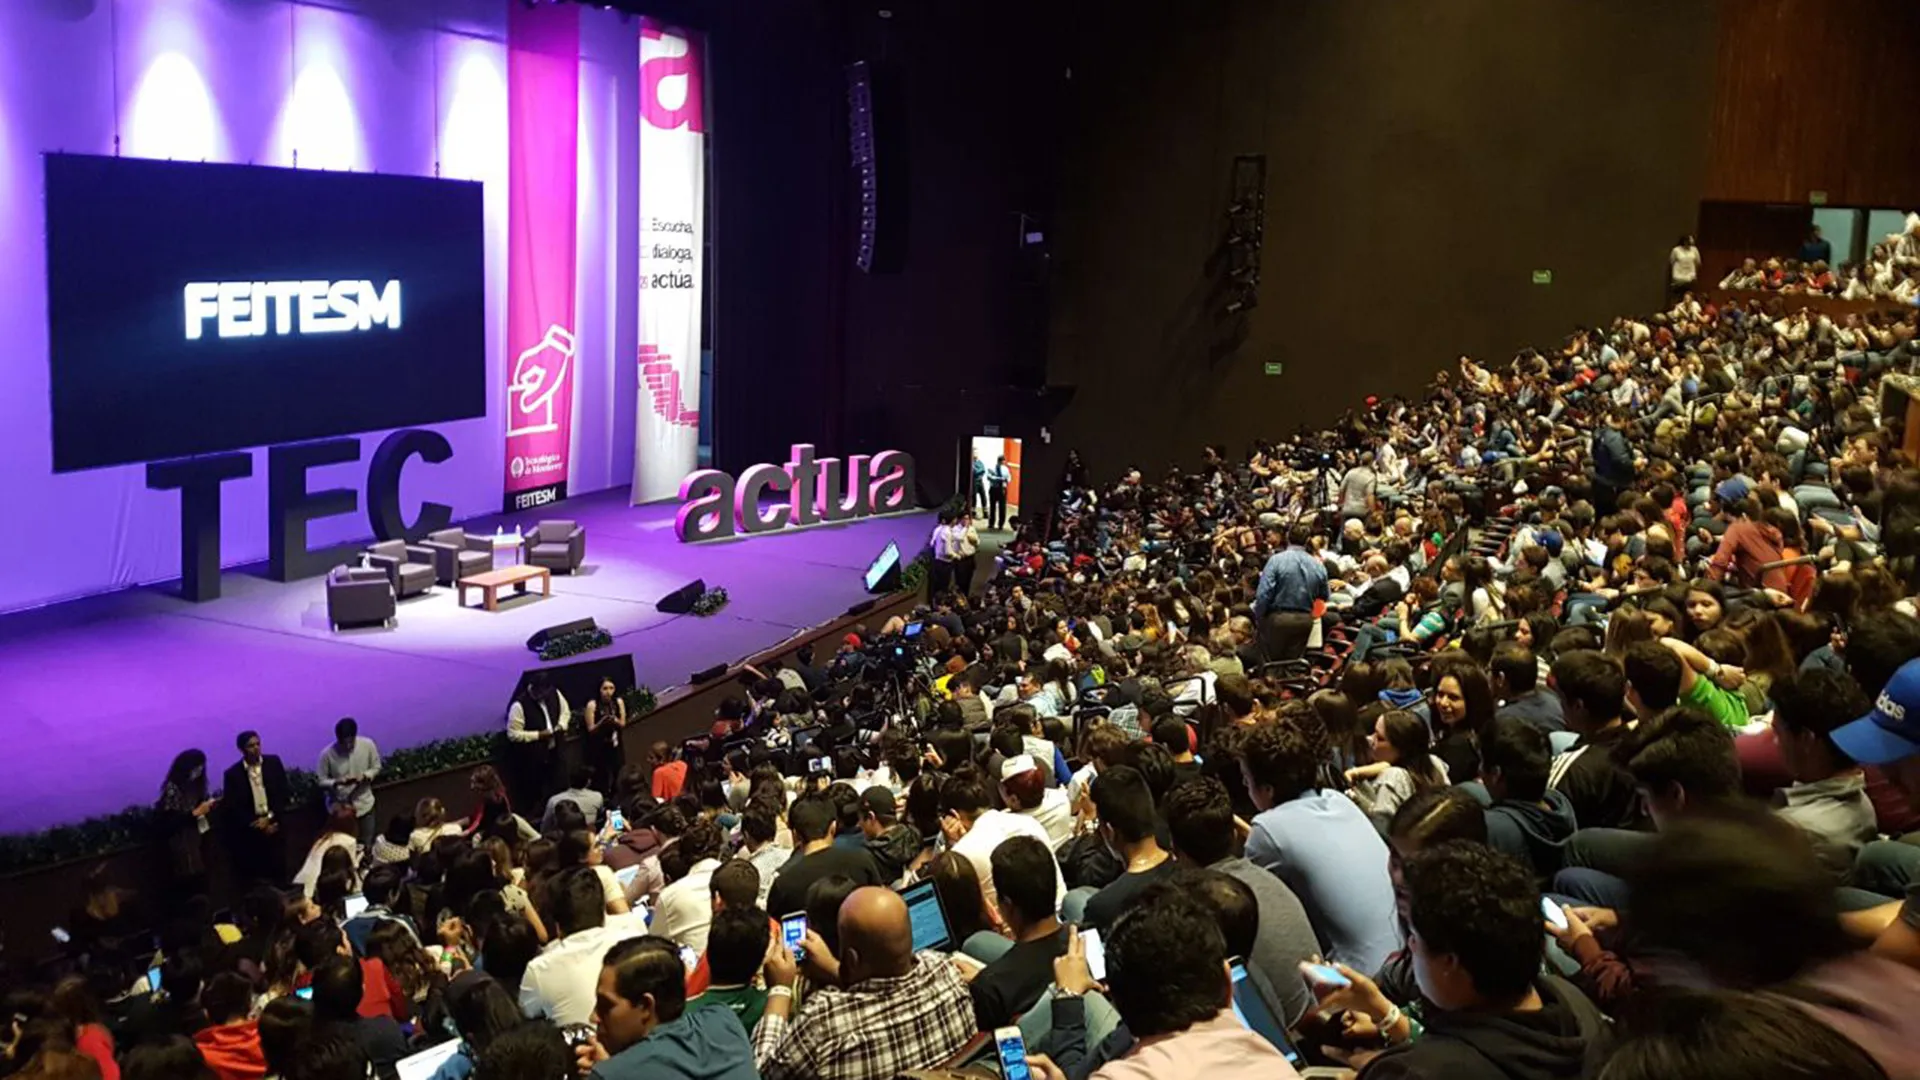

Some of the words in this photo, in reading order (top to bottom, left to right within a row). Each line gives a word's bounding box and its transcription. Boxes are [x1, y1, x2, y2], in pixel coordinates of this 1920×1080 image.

[184, 280, 401, 340] FEITESM
[146, 429, 454, 603] TEC
[515, 486, 557, 510] FEITESM
[674, 443, 916, 544] actua
